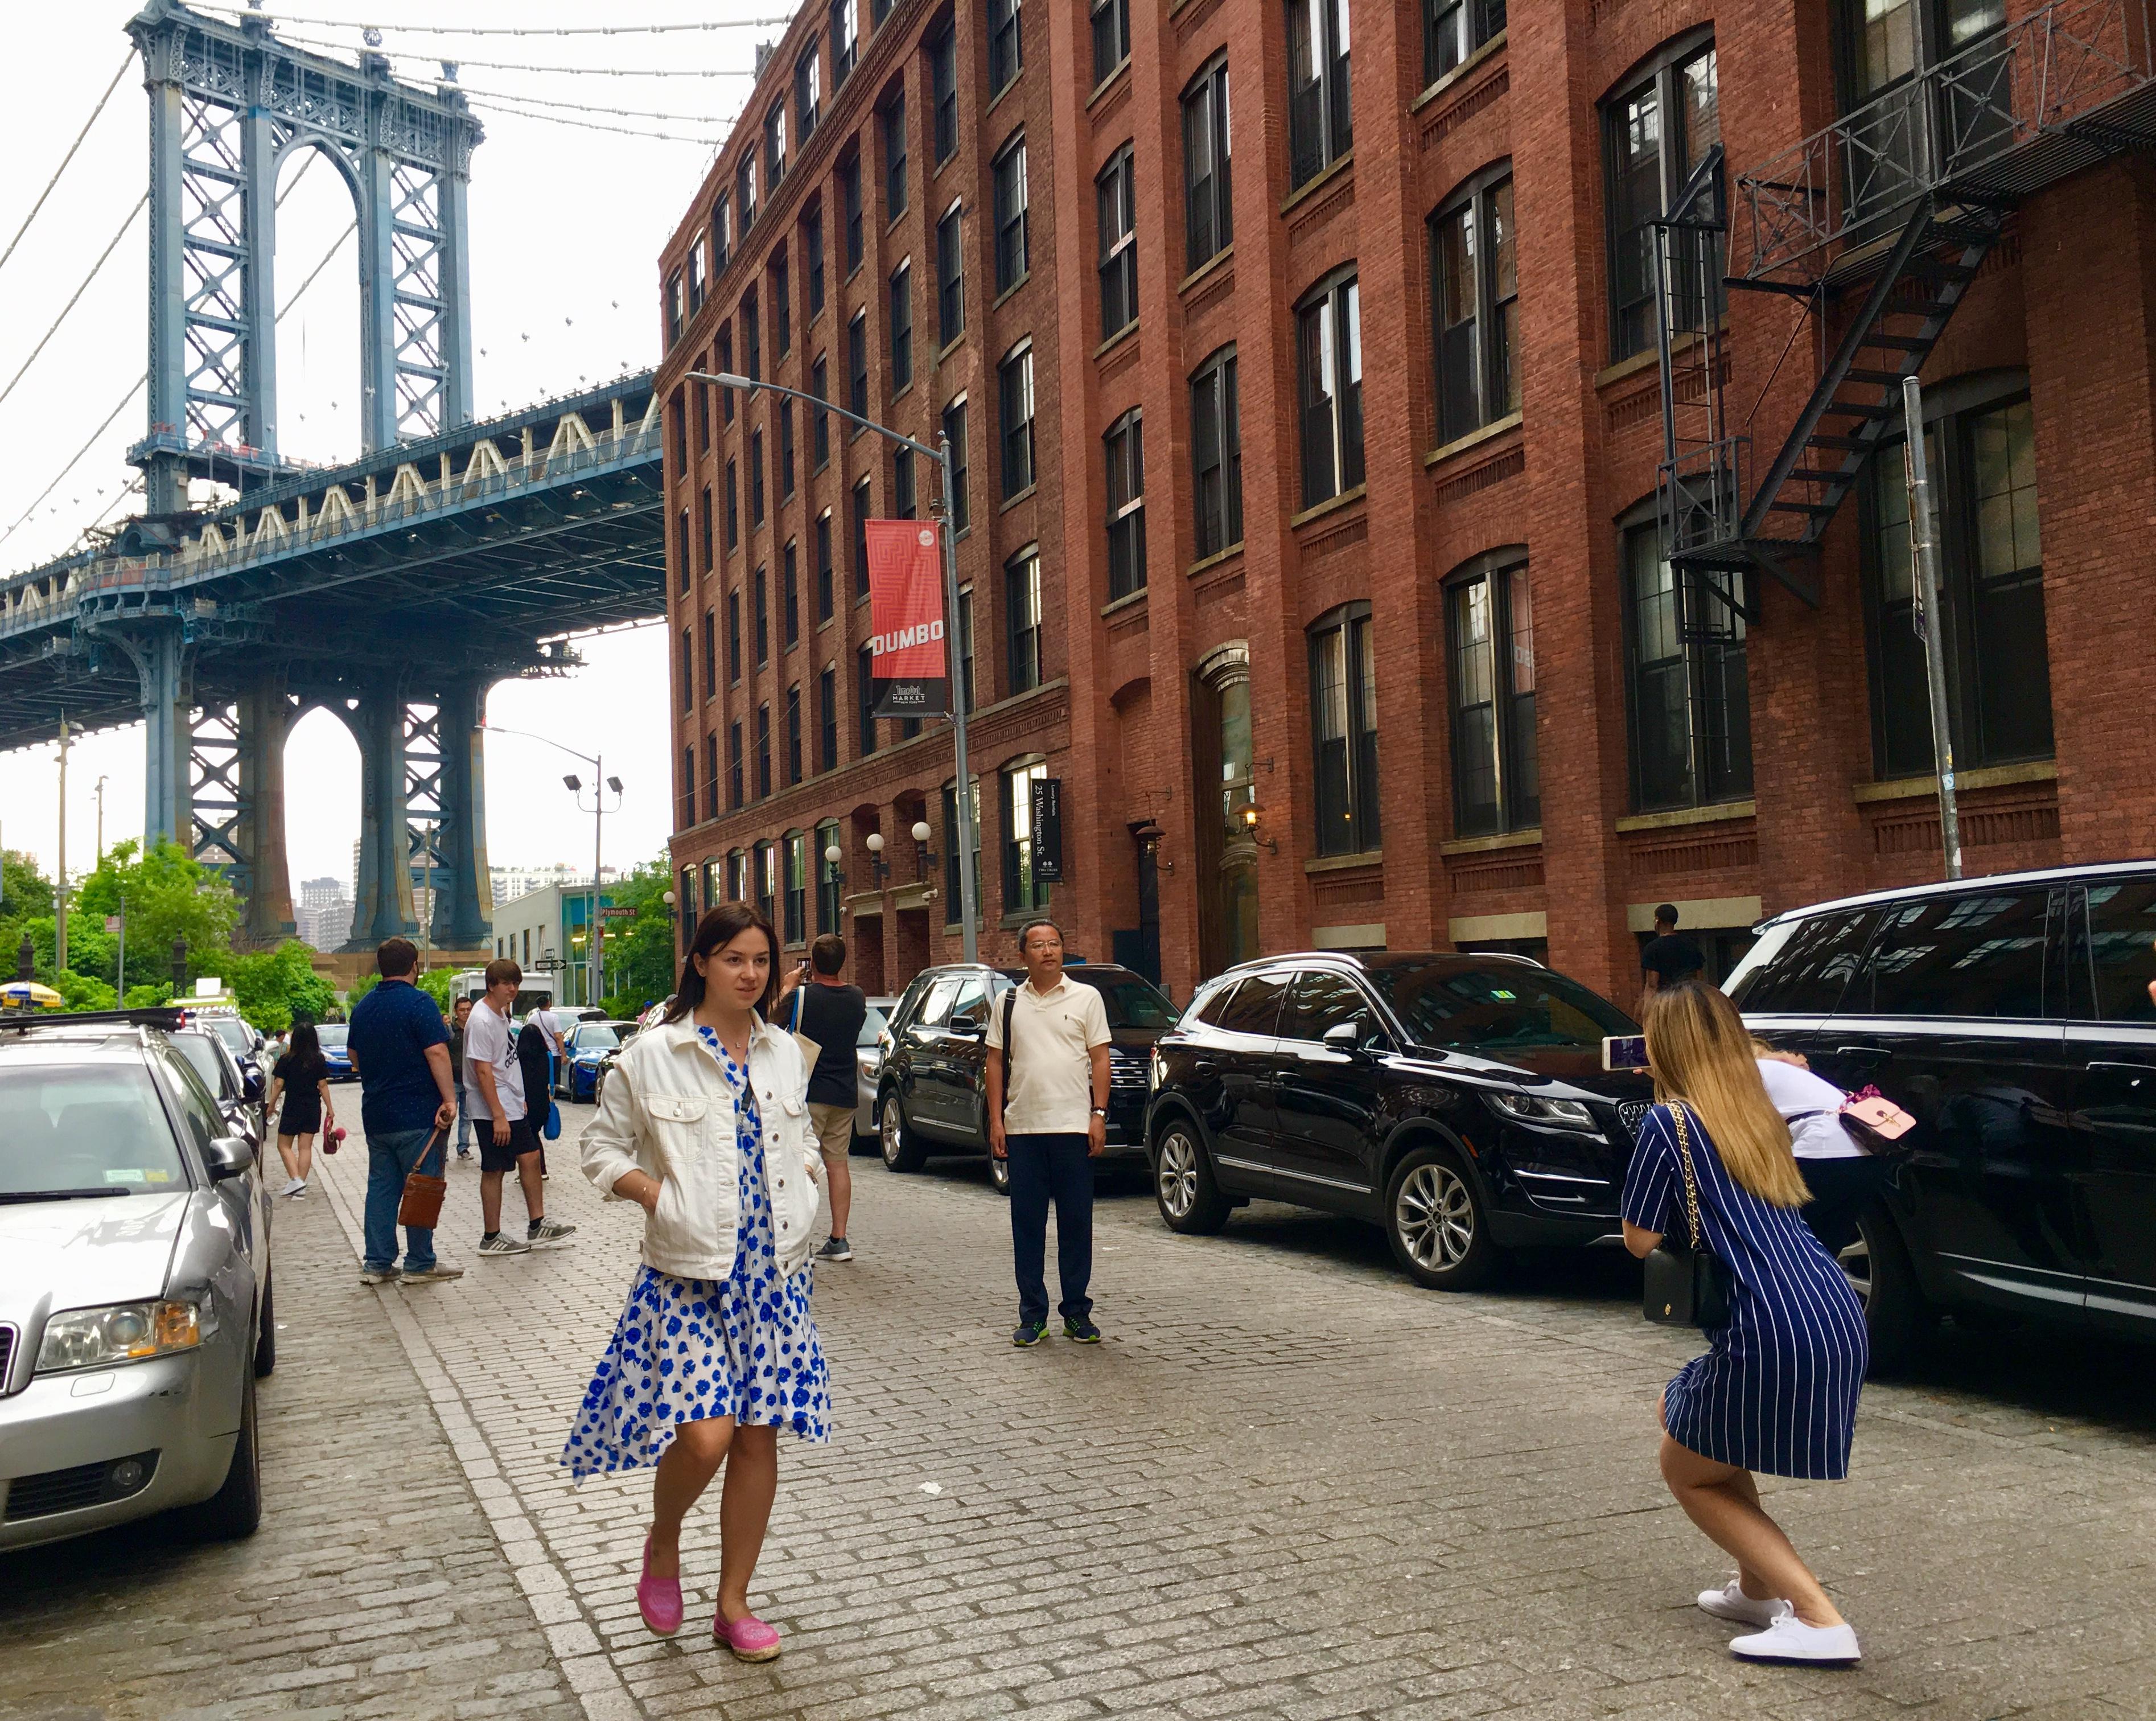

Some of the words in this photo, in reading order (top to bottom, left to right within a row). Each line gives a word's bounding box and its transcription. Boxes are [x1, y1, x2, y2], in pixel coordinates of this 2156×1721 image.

[872, 619, 944, 656] DUMBO
[1035, 784, 1043, 795] 25
[1034, 797, 1044, 844] Washington
[1036, 846, 1045, 857] St.
